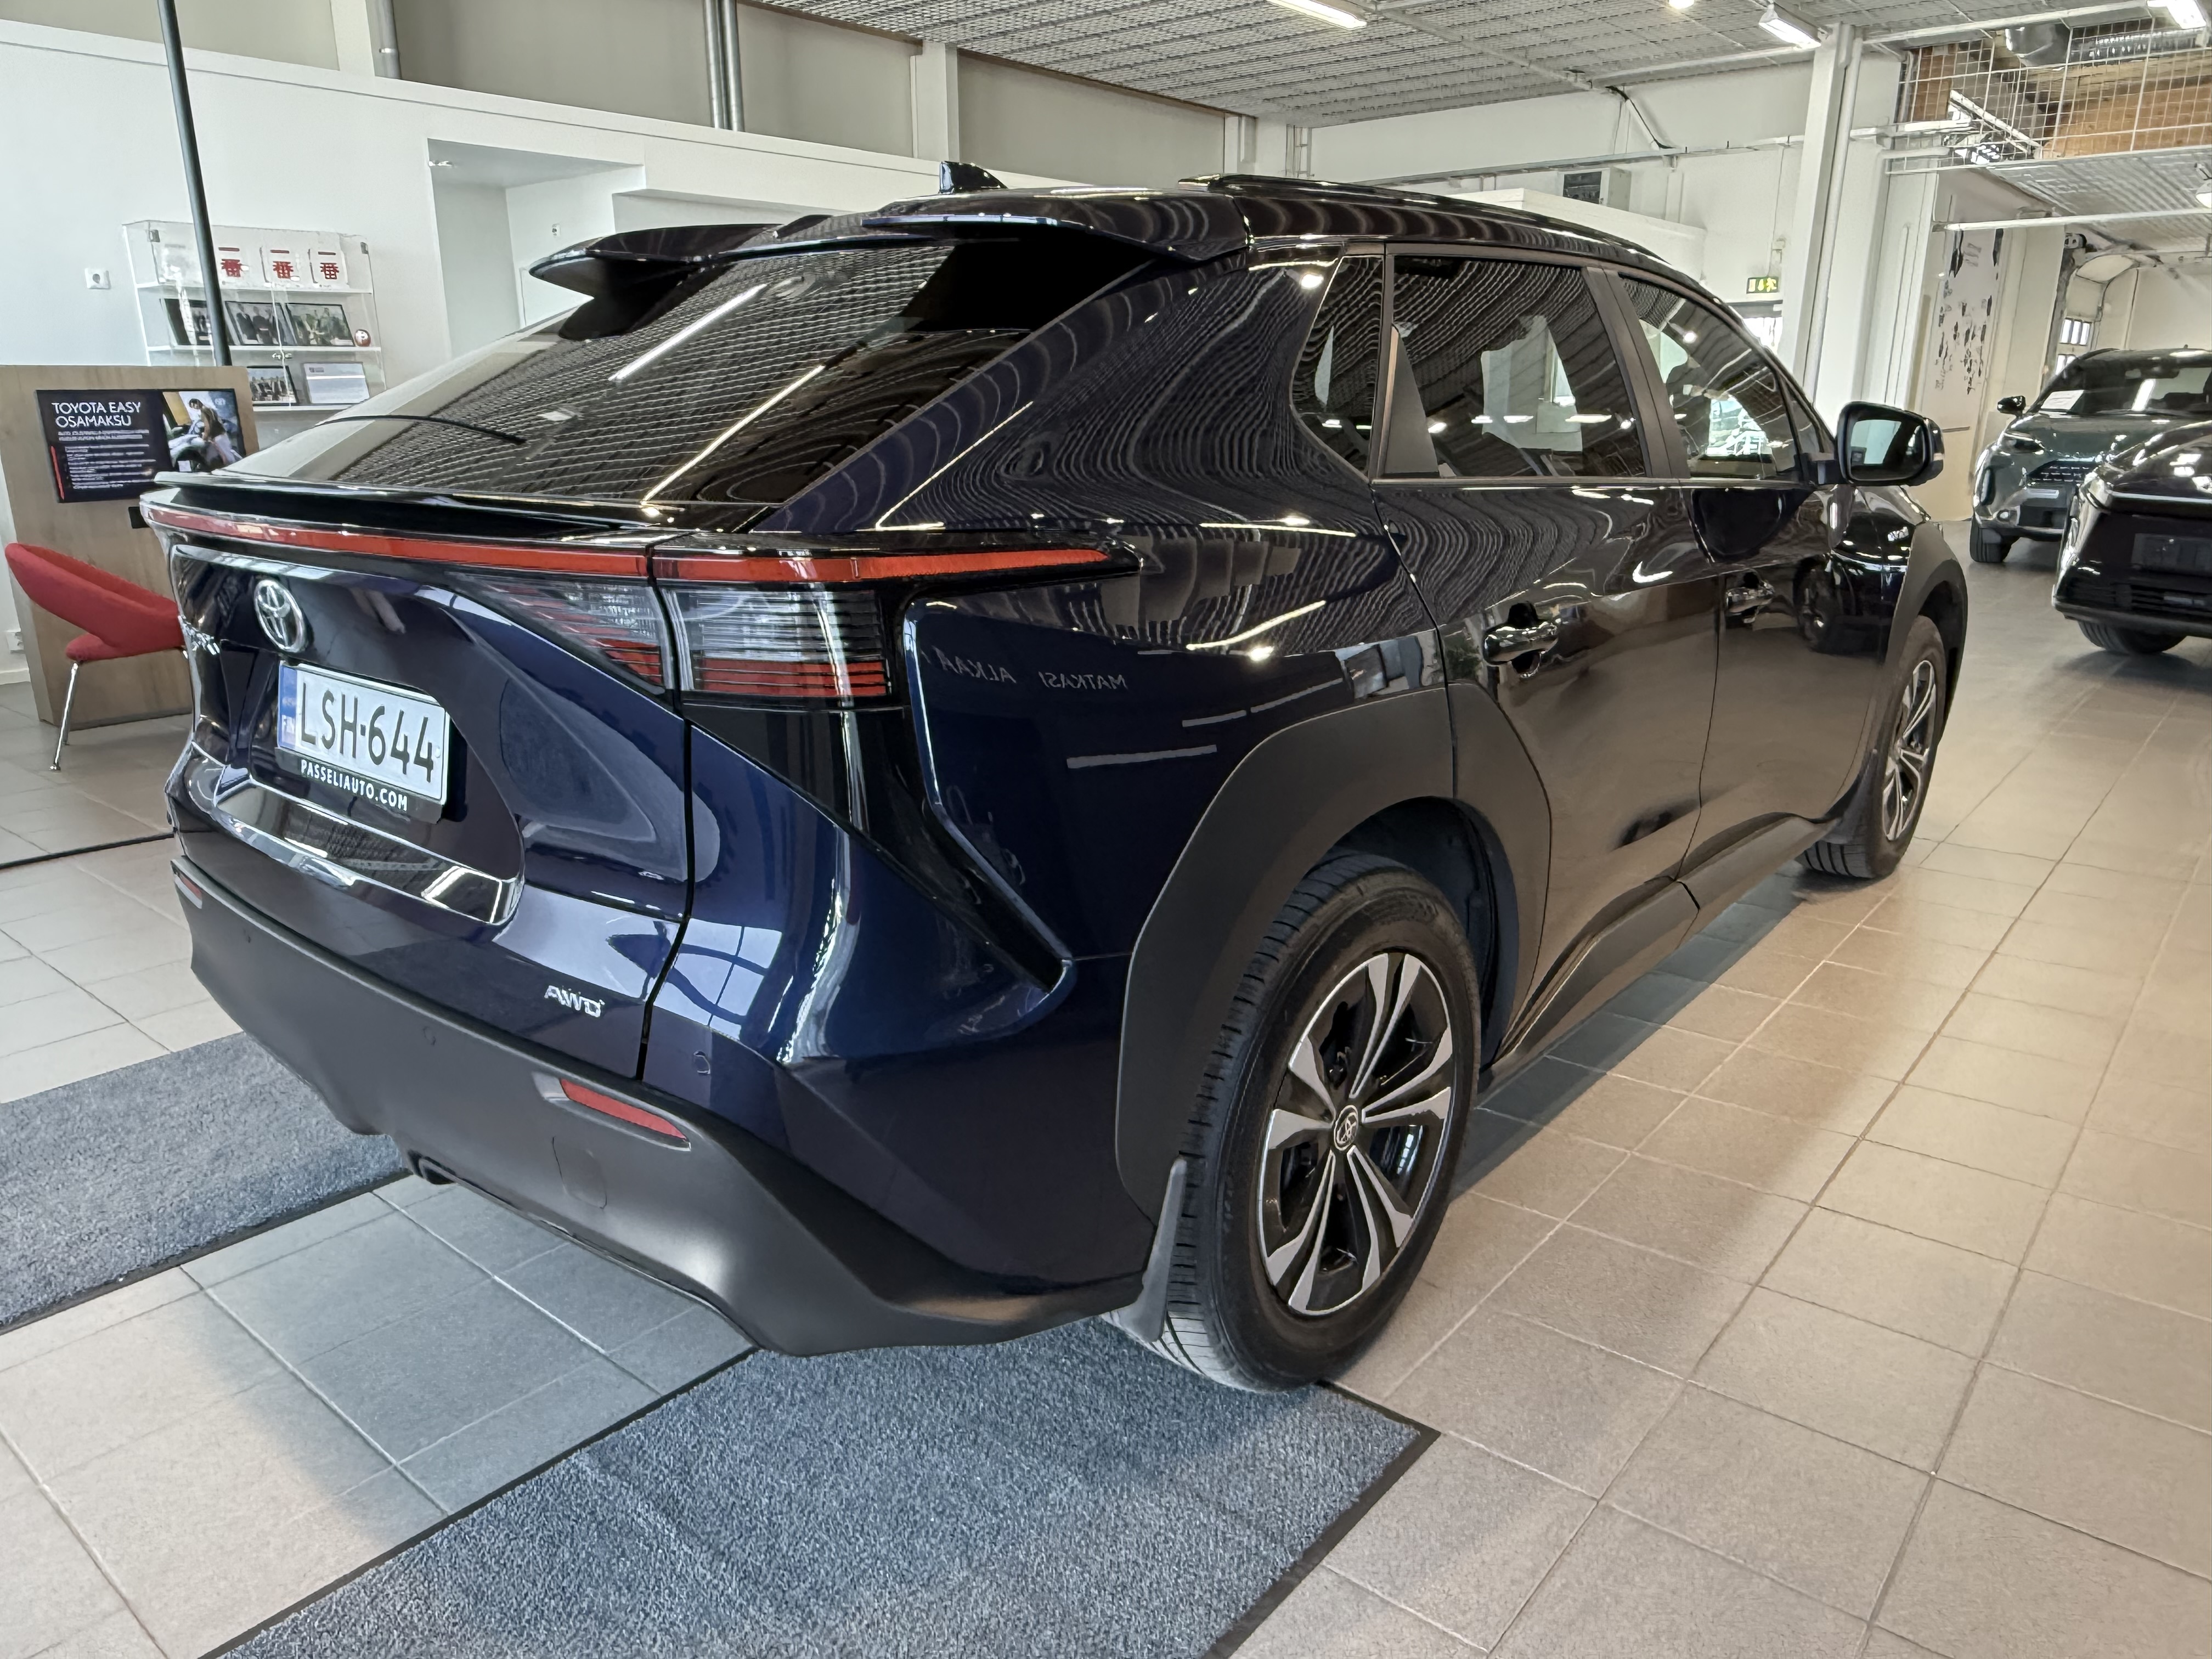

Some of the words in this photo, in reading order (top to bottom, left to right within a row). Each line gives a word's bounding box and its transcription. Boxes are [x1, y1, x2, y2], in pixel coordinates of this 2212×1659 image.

[52, 402, 106, 414] TOYOTA
[109, 402, 140, 413] EASY
[55, 415, 132, 428] OSAMAKSU
[301, 759, 408, 811] PASSELIAUTO.COM
[544, 985, 605, 1018] AWD
